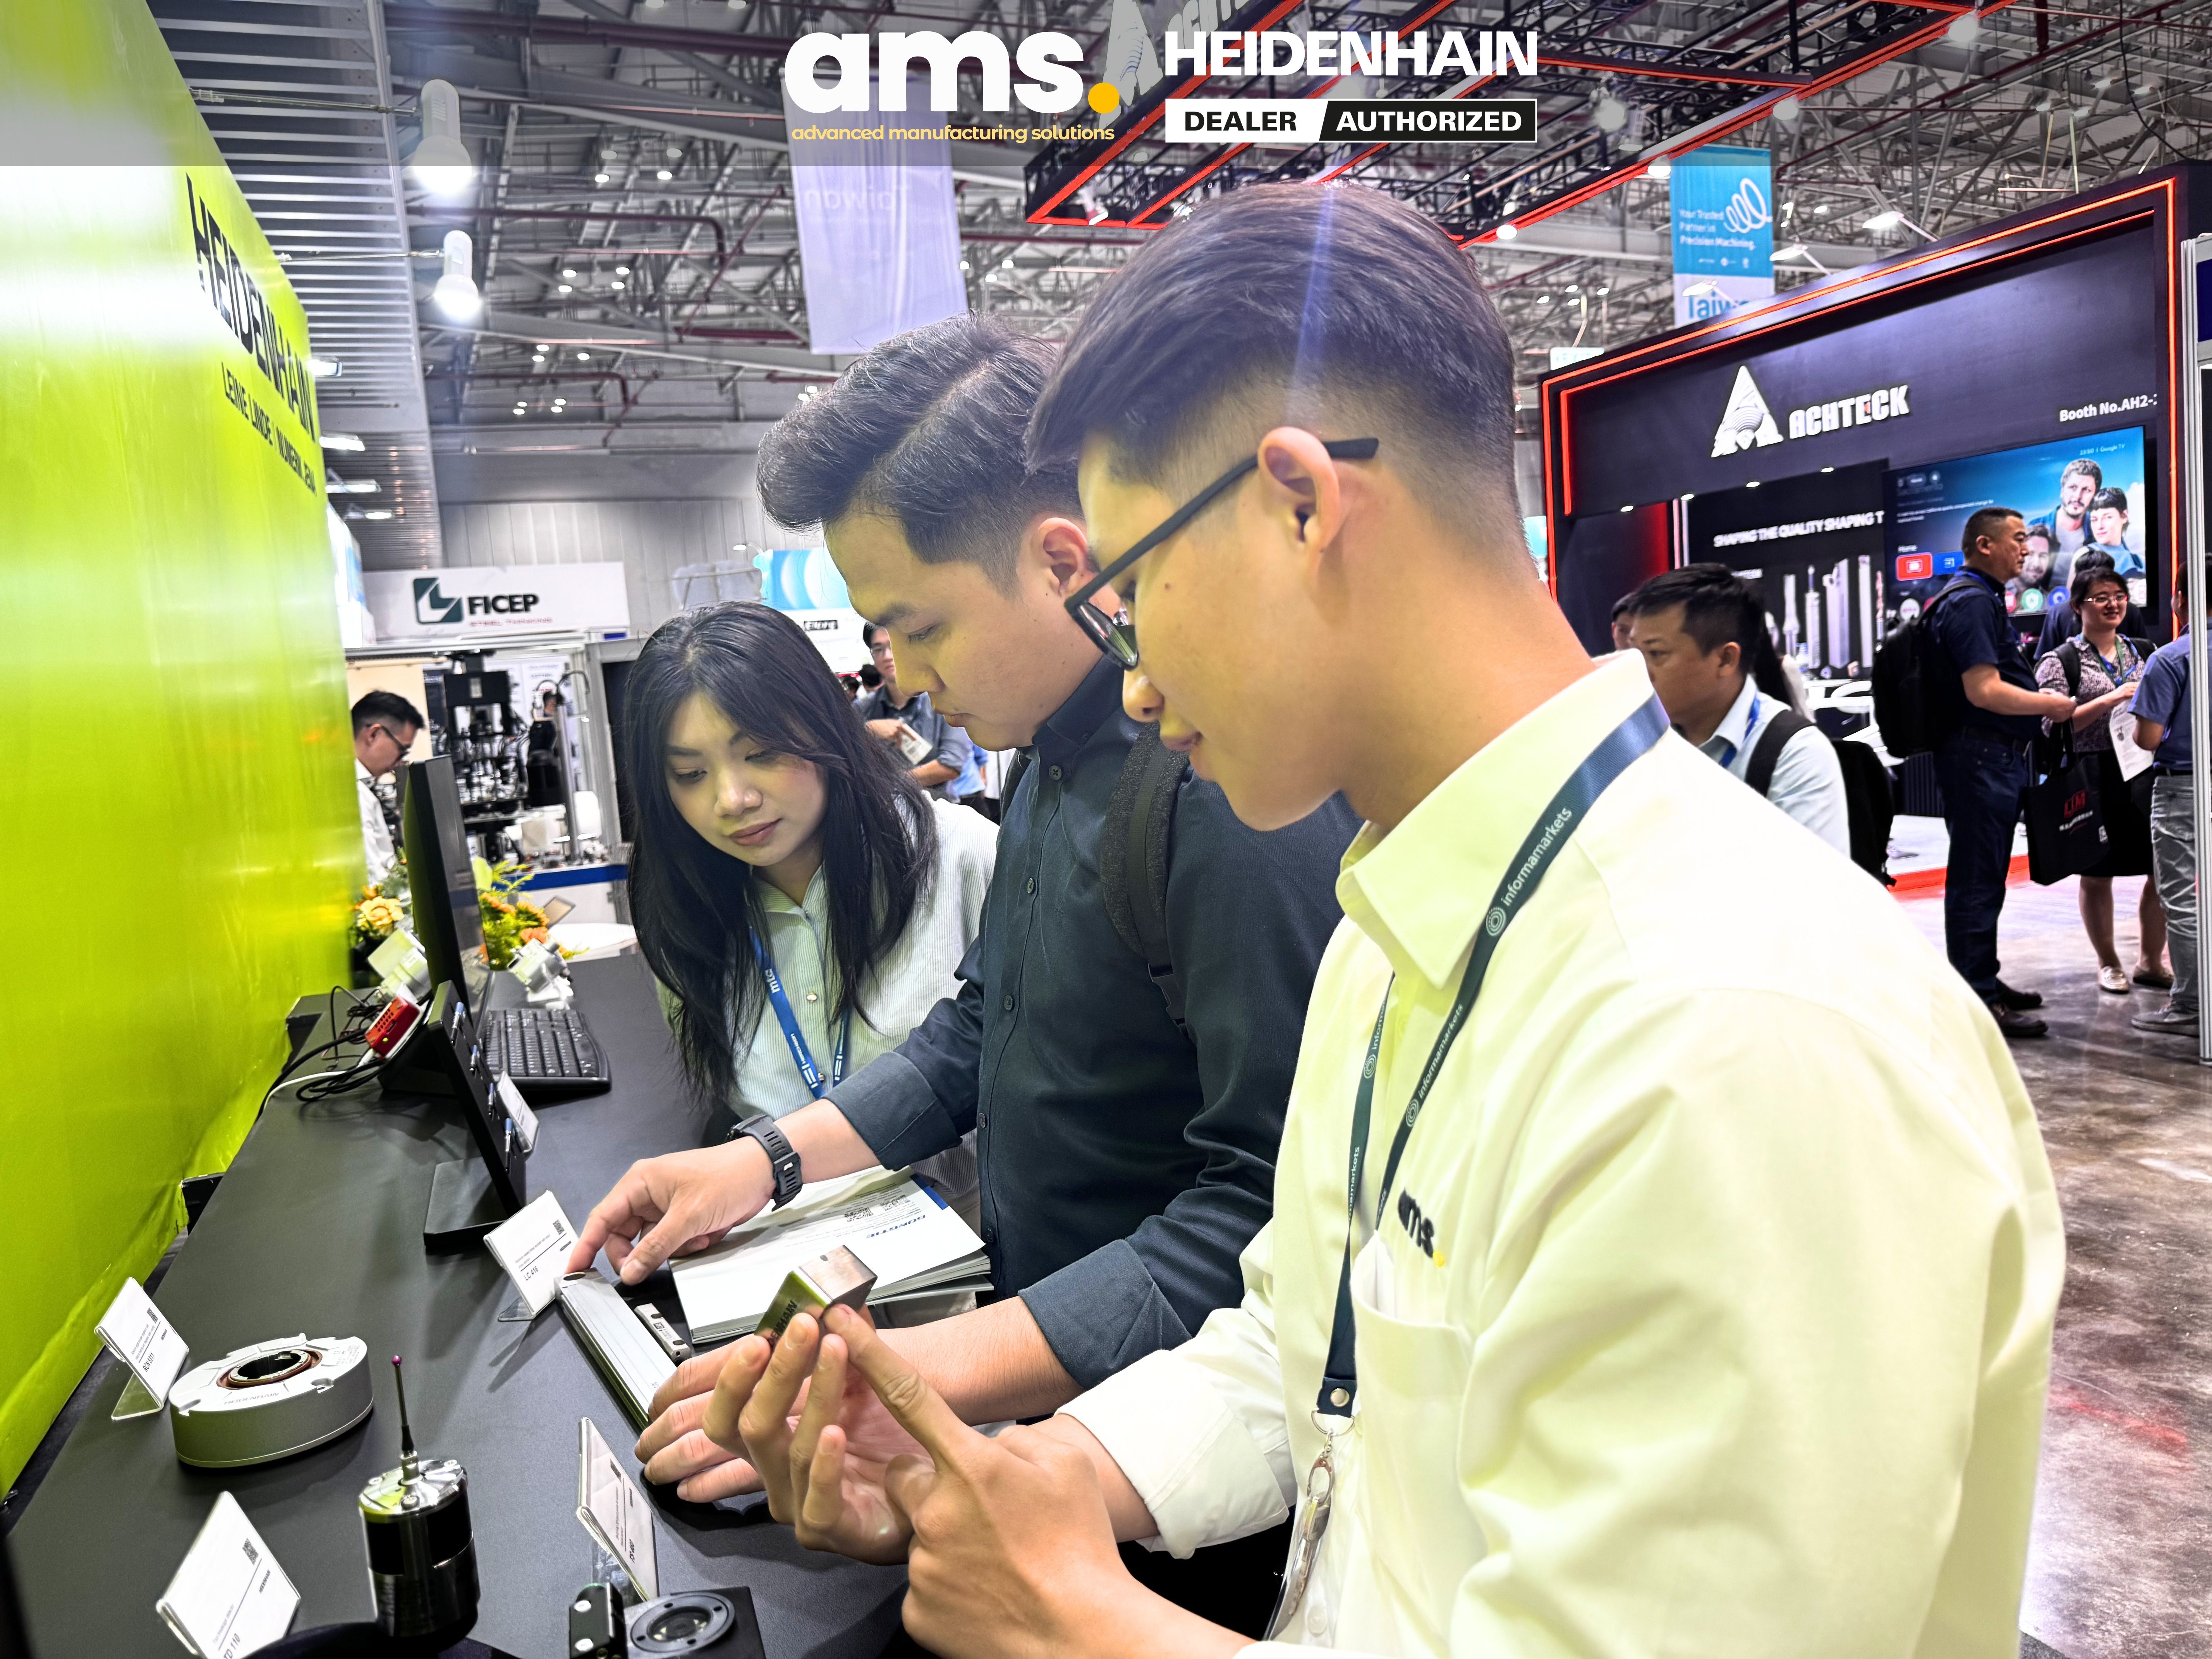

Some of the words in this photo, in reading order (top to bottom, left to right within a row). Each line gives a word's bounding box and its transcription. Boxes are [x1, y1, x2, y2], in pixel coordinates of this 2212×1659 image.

[186, 172, 316, 442] HEIDENHAIN
[222, 361, 249, 420] LEINE
[249, 393, 273, 446] LINDE
[1789, 385, 1910, 439] ACHTECK
[2059, 404, 2097, 422] Booth
[2099, 393, 2157, 415] No.AH2-
[2100, 445, 2118, 453] Google
[1713, 529, 1758, 548] SHAPING
[1757, 526, 1778, 541] THE
[1778, 519, 1824, 538] QUALITY
[1824, 512, 1875, 532] SHAPING
[467, 593, 539, 616] FICEP
[1501, 807, 1573, 907] informamarkets
[1418, 1003, 1463, 1099] informamarkets
[524, 1272, 532, 1281] LC
[143, 1360, 151, 1372] RCN
[224, 1392, 279, 1405] HEIDENHAIN
